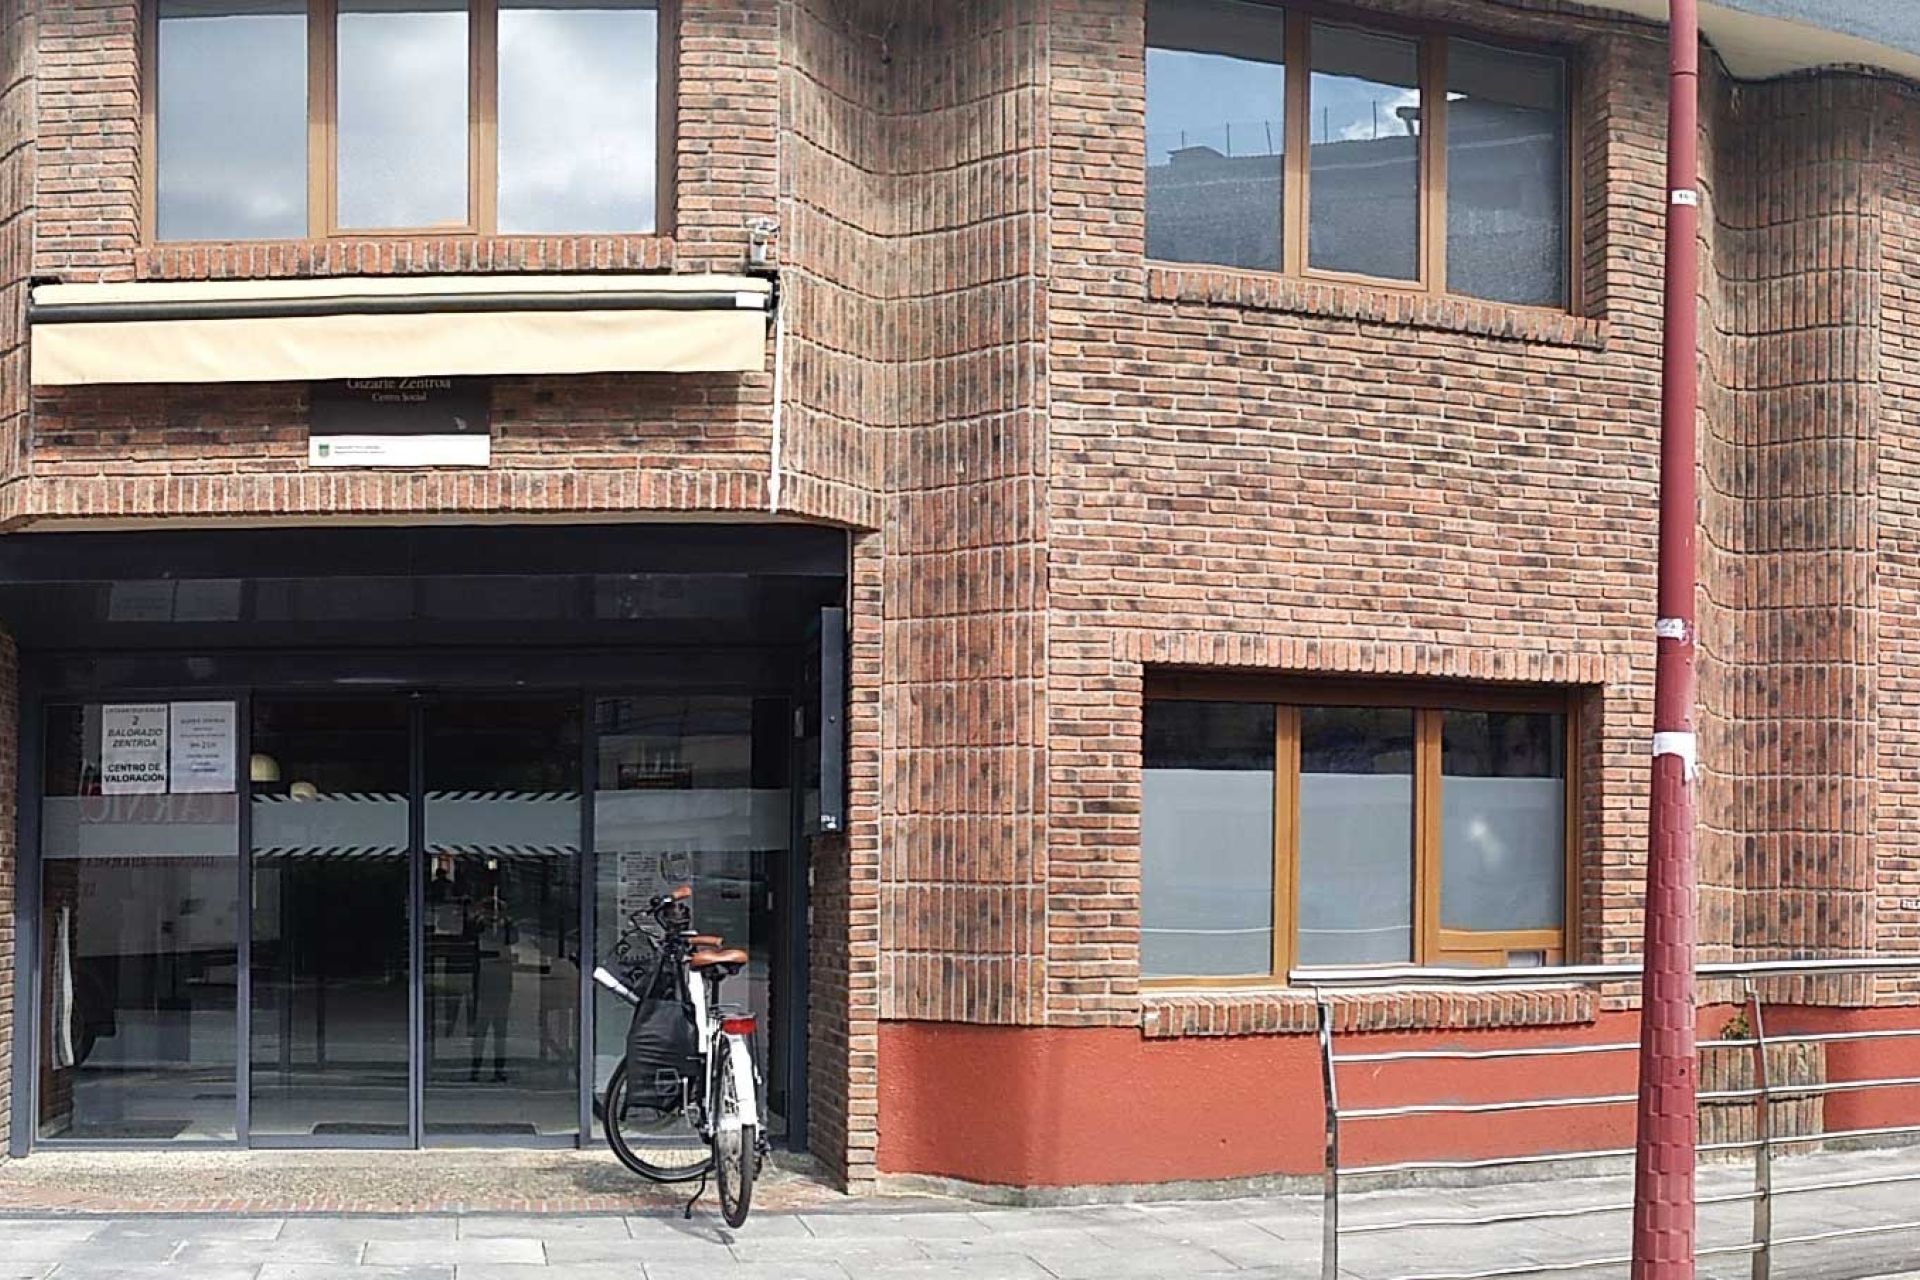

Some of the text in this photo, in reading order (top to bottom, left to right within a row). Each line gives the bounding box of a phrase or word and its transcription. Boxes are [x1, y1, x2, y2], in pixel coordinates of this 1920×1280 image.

[402, 391, 426, 401] Social
[131, 715, 140, 726] 2
[107, 728, 164, 737] BALORAZIO
[112, 739, 158, 748] ZENTROA
[108, 763, 161, 772] CENTRO DE
[104, 772, 165, 782] VALORACIÓN
